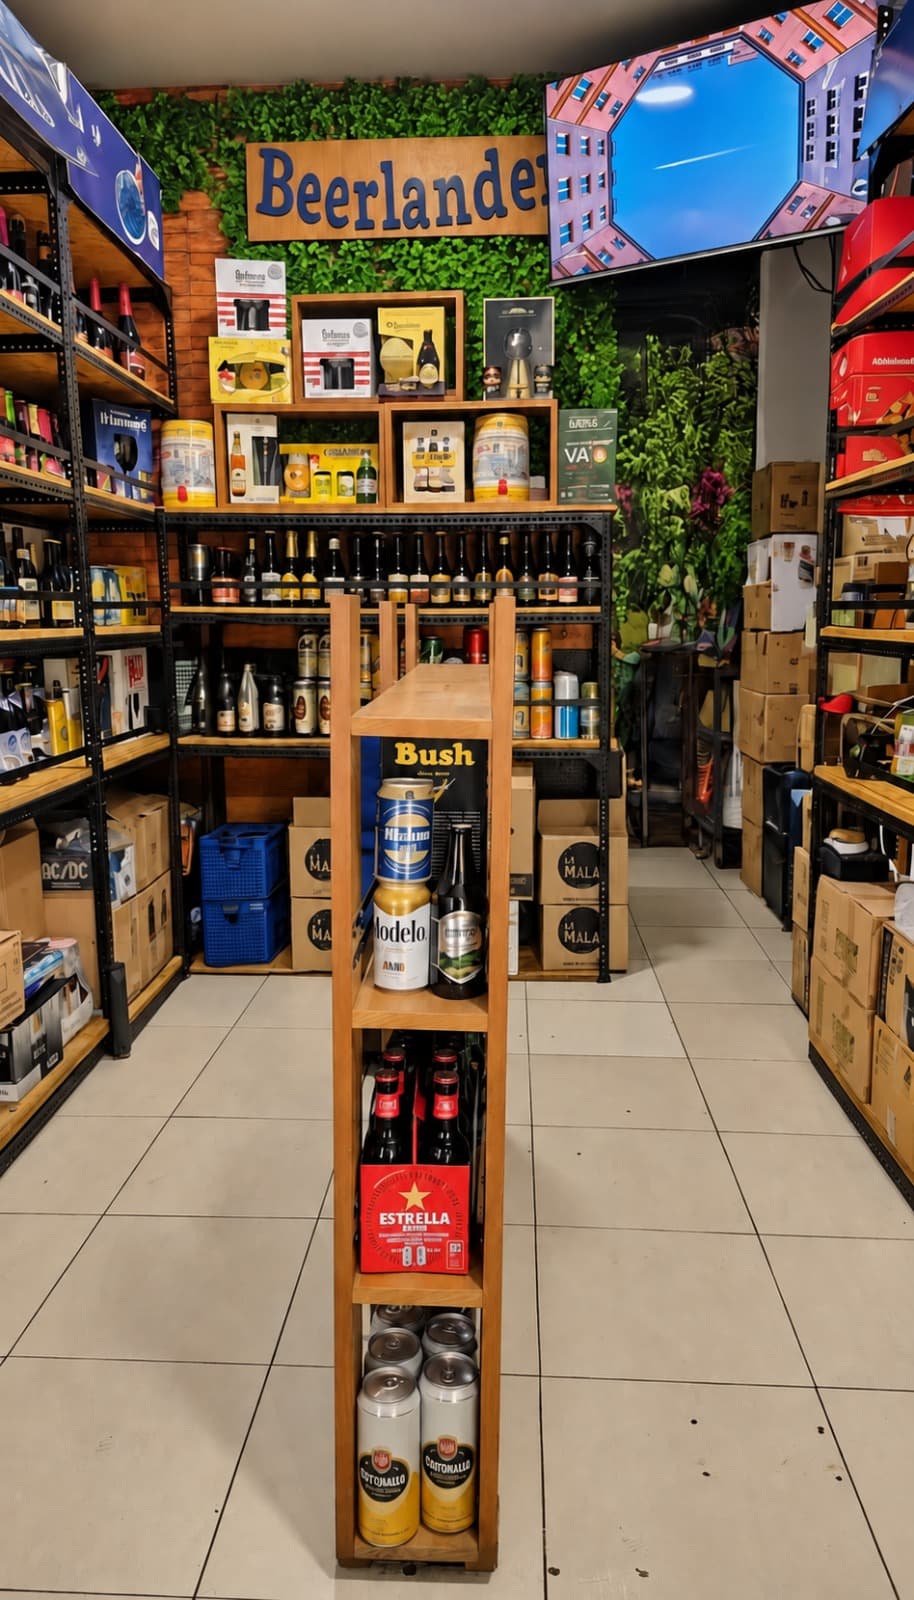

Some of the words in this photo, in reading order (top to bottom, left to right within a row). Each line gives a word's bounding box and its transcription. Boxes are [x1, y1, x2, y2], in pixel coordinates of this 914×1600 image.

[394, 742, 476, 766] Bush
[41, 861, 89, 880] AC/DC
[564, 865, 600, 879] MALA
[564, 930, 600, 944] MALA
[379, 1212, 450, 1225] ESTRELLA
